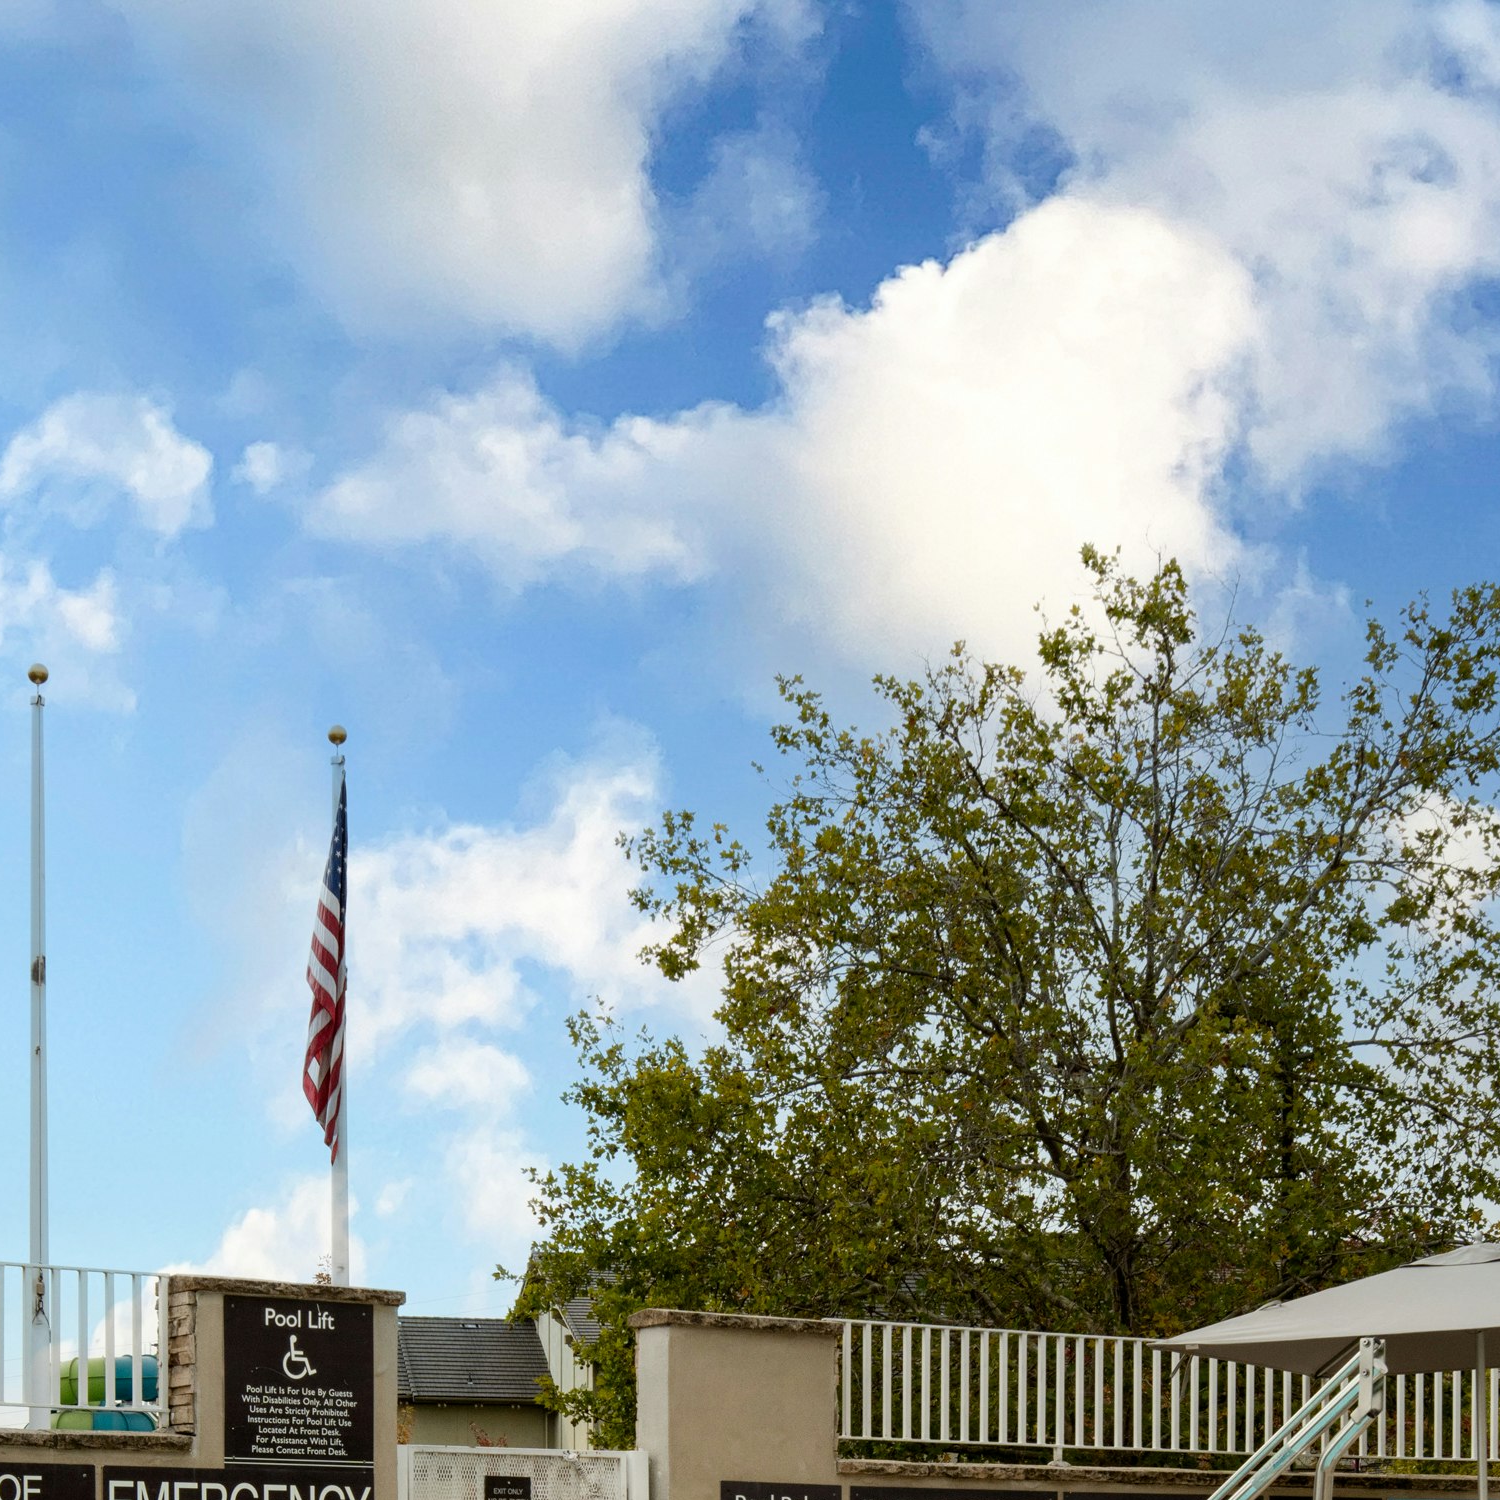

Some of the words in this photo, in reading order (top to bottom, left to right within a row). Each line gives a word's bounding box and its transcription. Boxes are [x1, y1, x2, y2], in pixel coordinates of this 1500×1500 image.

[265, 1307, 301, 1328] Pool
[308, 1311, 335, 1330] Lift
[246, 1384, 263, 1393] Pool
[264, 1385, 277, 1394] Lift
[279, 1386, 285, 1394] Is
[287, 1386, 300, 1395] For
[301, 1387, 316, 1396] Use
[317, 1388, 327, 1398] By
[328, 1388, 353, 1398] Guests
[241, 1394, 260, 1403] With
[262, 1395, 301, 1405] Disabilities
[302, 1397, 321, 1408] Only.
[323, 1398, 333, 1406] All
[335, 1399, 357, 1407] Other
[249, 1405, 267, 1413] Uses
[269, 1406, 283, 1414] Are
[285, 1406, 310, 1417] Strictly
[312, 1407, 350, 1417] Prohibited.
[247, 1415, 290, 1424] Instructions
[292, 1416, 305, 1425] For
[306, 1417, 322, 1426] Pool
[324, 1418, 336, 1426] Lift
[338, 1418, 352, 1427] Use
[258, 1425, 287, 1434] Located
[288, 1426, 298, 1435] At
[300, 1426, 319, 1435] Front
[321, 1427, 341, 1436] Desk.
[256, 1435, 269, 1444] For
[270, 1436, 308, 1445] Assistance
[309, 1437, 328, 1445] With
[330, 1438, 344, 1447] Lift,
[251, 1445, 274, 1454] Please
[276, 1445, 305, 1455] Contact
[307, 1446, 326, 1455] Front
[328, 1447, 348, 1456] Desk.
[493, 1487, 507, 1495] EXIT
